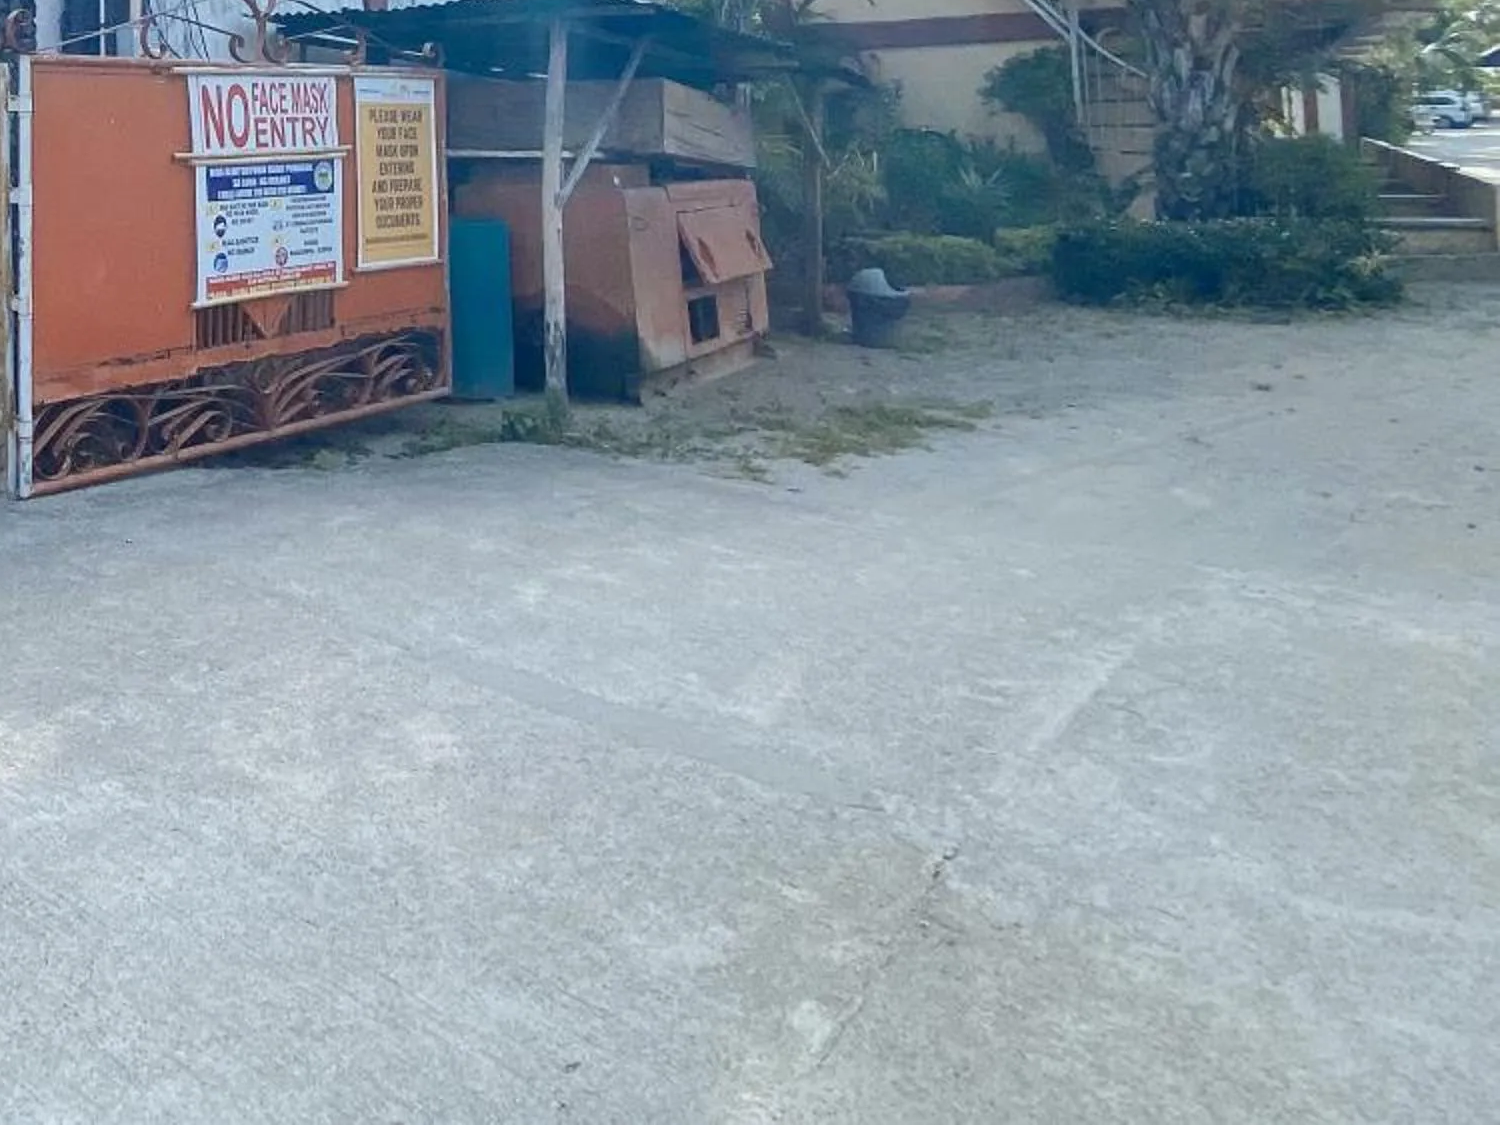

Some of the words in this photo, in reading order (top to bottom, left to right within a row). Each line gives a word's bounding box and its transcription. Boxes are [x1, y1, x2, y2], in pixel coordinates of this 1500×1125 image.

[251, 82, 288, 114] FACE
[290, 82, 329, 115] MASK
[202, 83, 250, 149] NO
[369, 108, 398, 124] PLEASE
[401, 109, 423, 124] WEAR
[255, 117, 329, 148] ENTRY
[376, 126, 397, 140] YOUR
[399, 126, 418, 140] FACE
[375, 144, 398, 157] MASK
[371, 180, 389, 194] AND
[374, 197, 395, 211] YOUR
